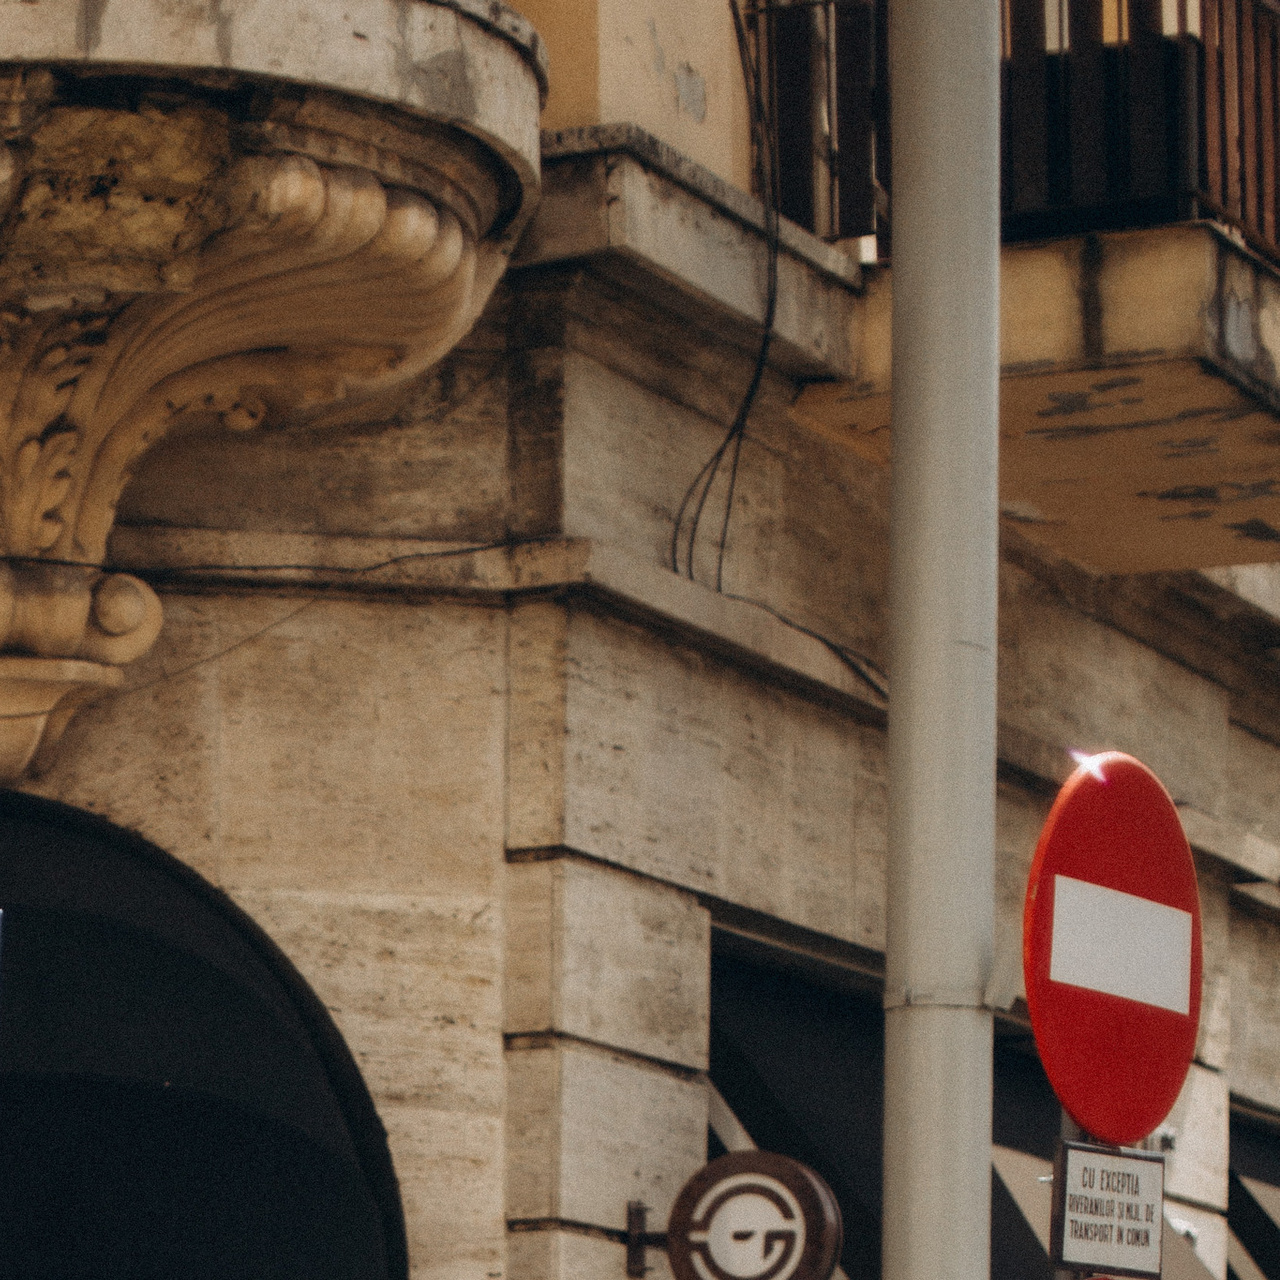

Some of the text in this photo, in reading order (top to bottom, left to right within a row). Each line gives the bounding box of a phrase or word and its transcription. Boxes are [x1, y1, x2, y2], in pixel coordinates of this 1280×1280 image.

[1081, 1166, 1140, 1197] CU EXCEPTIA
[1144, 1203, 1155, 1223] DE
[1069, 1220, 1114, 1244] TRANSPORT
